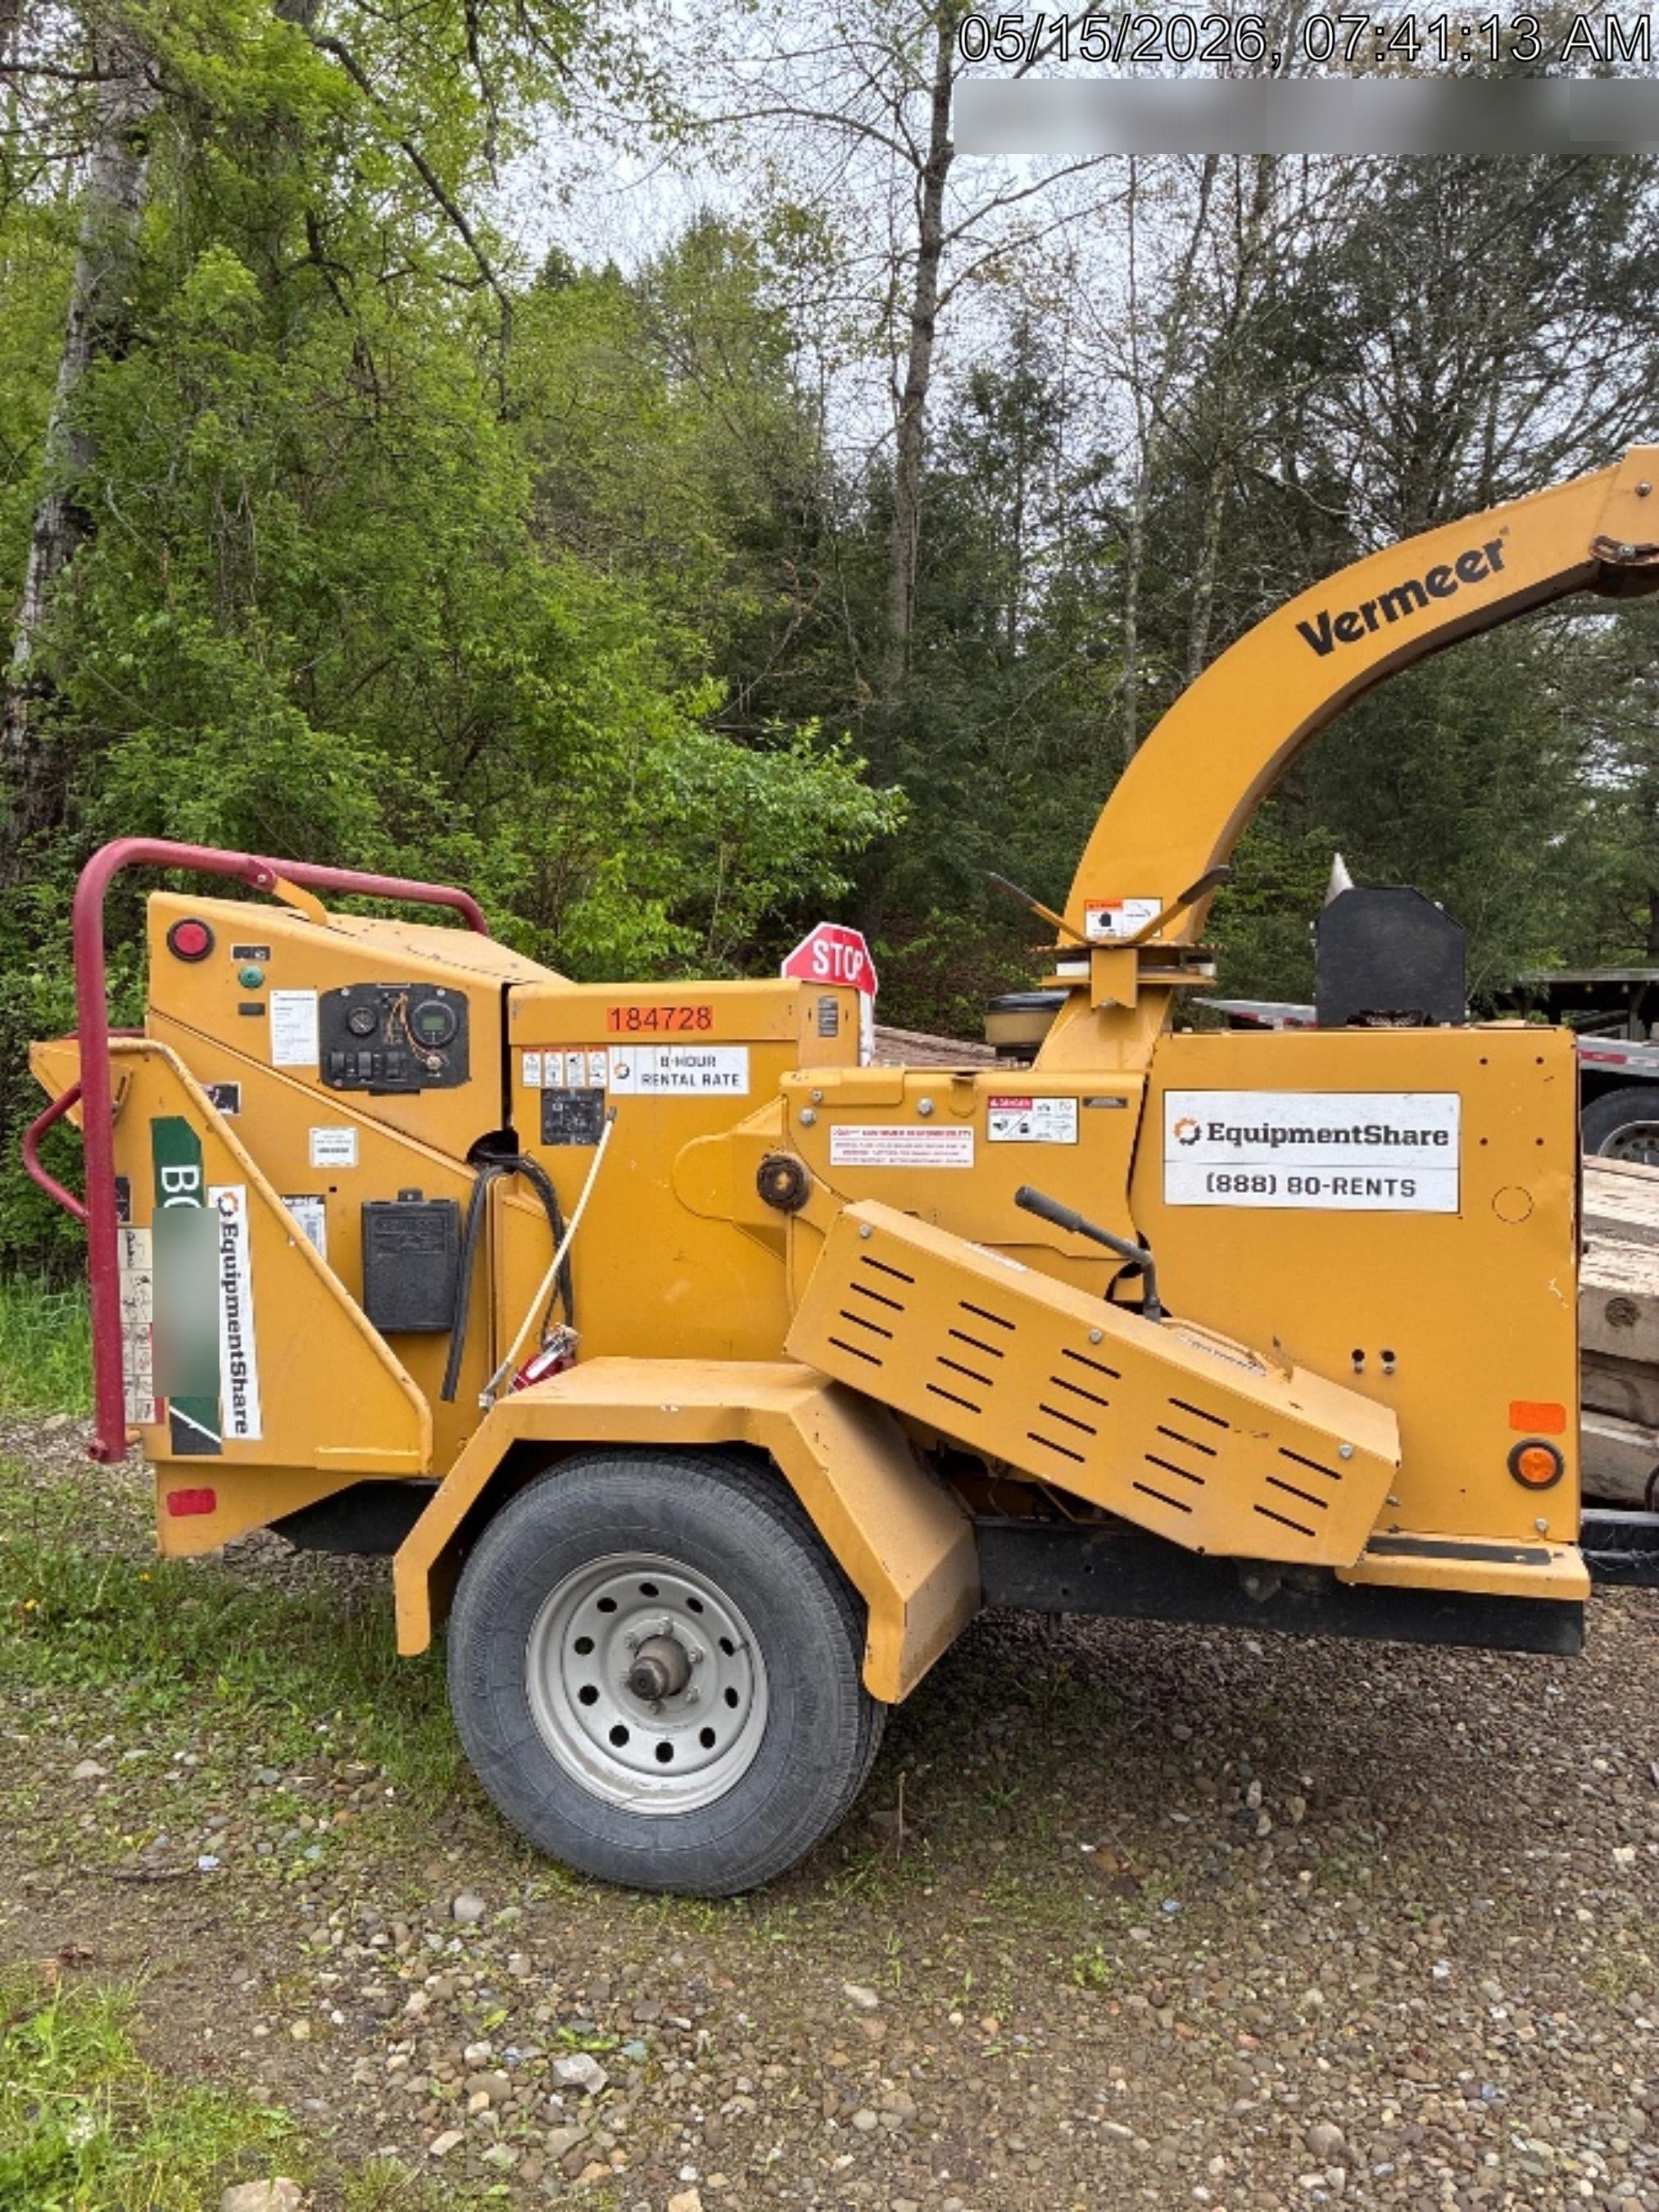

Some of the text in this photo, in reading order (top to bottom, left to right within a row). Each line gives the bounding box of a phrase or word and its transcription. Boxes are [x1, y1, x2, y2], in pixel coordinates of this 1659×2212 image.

[1296, 537, 1506, 657] Vermeer
[812, 939, 863, 981] STOP
[611, 1007, 712, 1031] 184728
[641, 1073, 741, 1087] RENTAL RATE
[1207, 1122, 1449, 1149] EquipmentShare
[1206, 1172, 1416, 1198] (888) 80-RENTS
[220, 1223, 249, 1435] EquipmentShare
